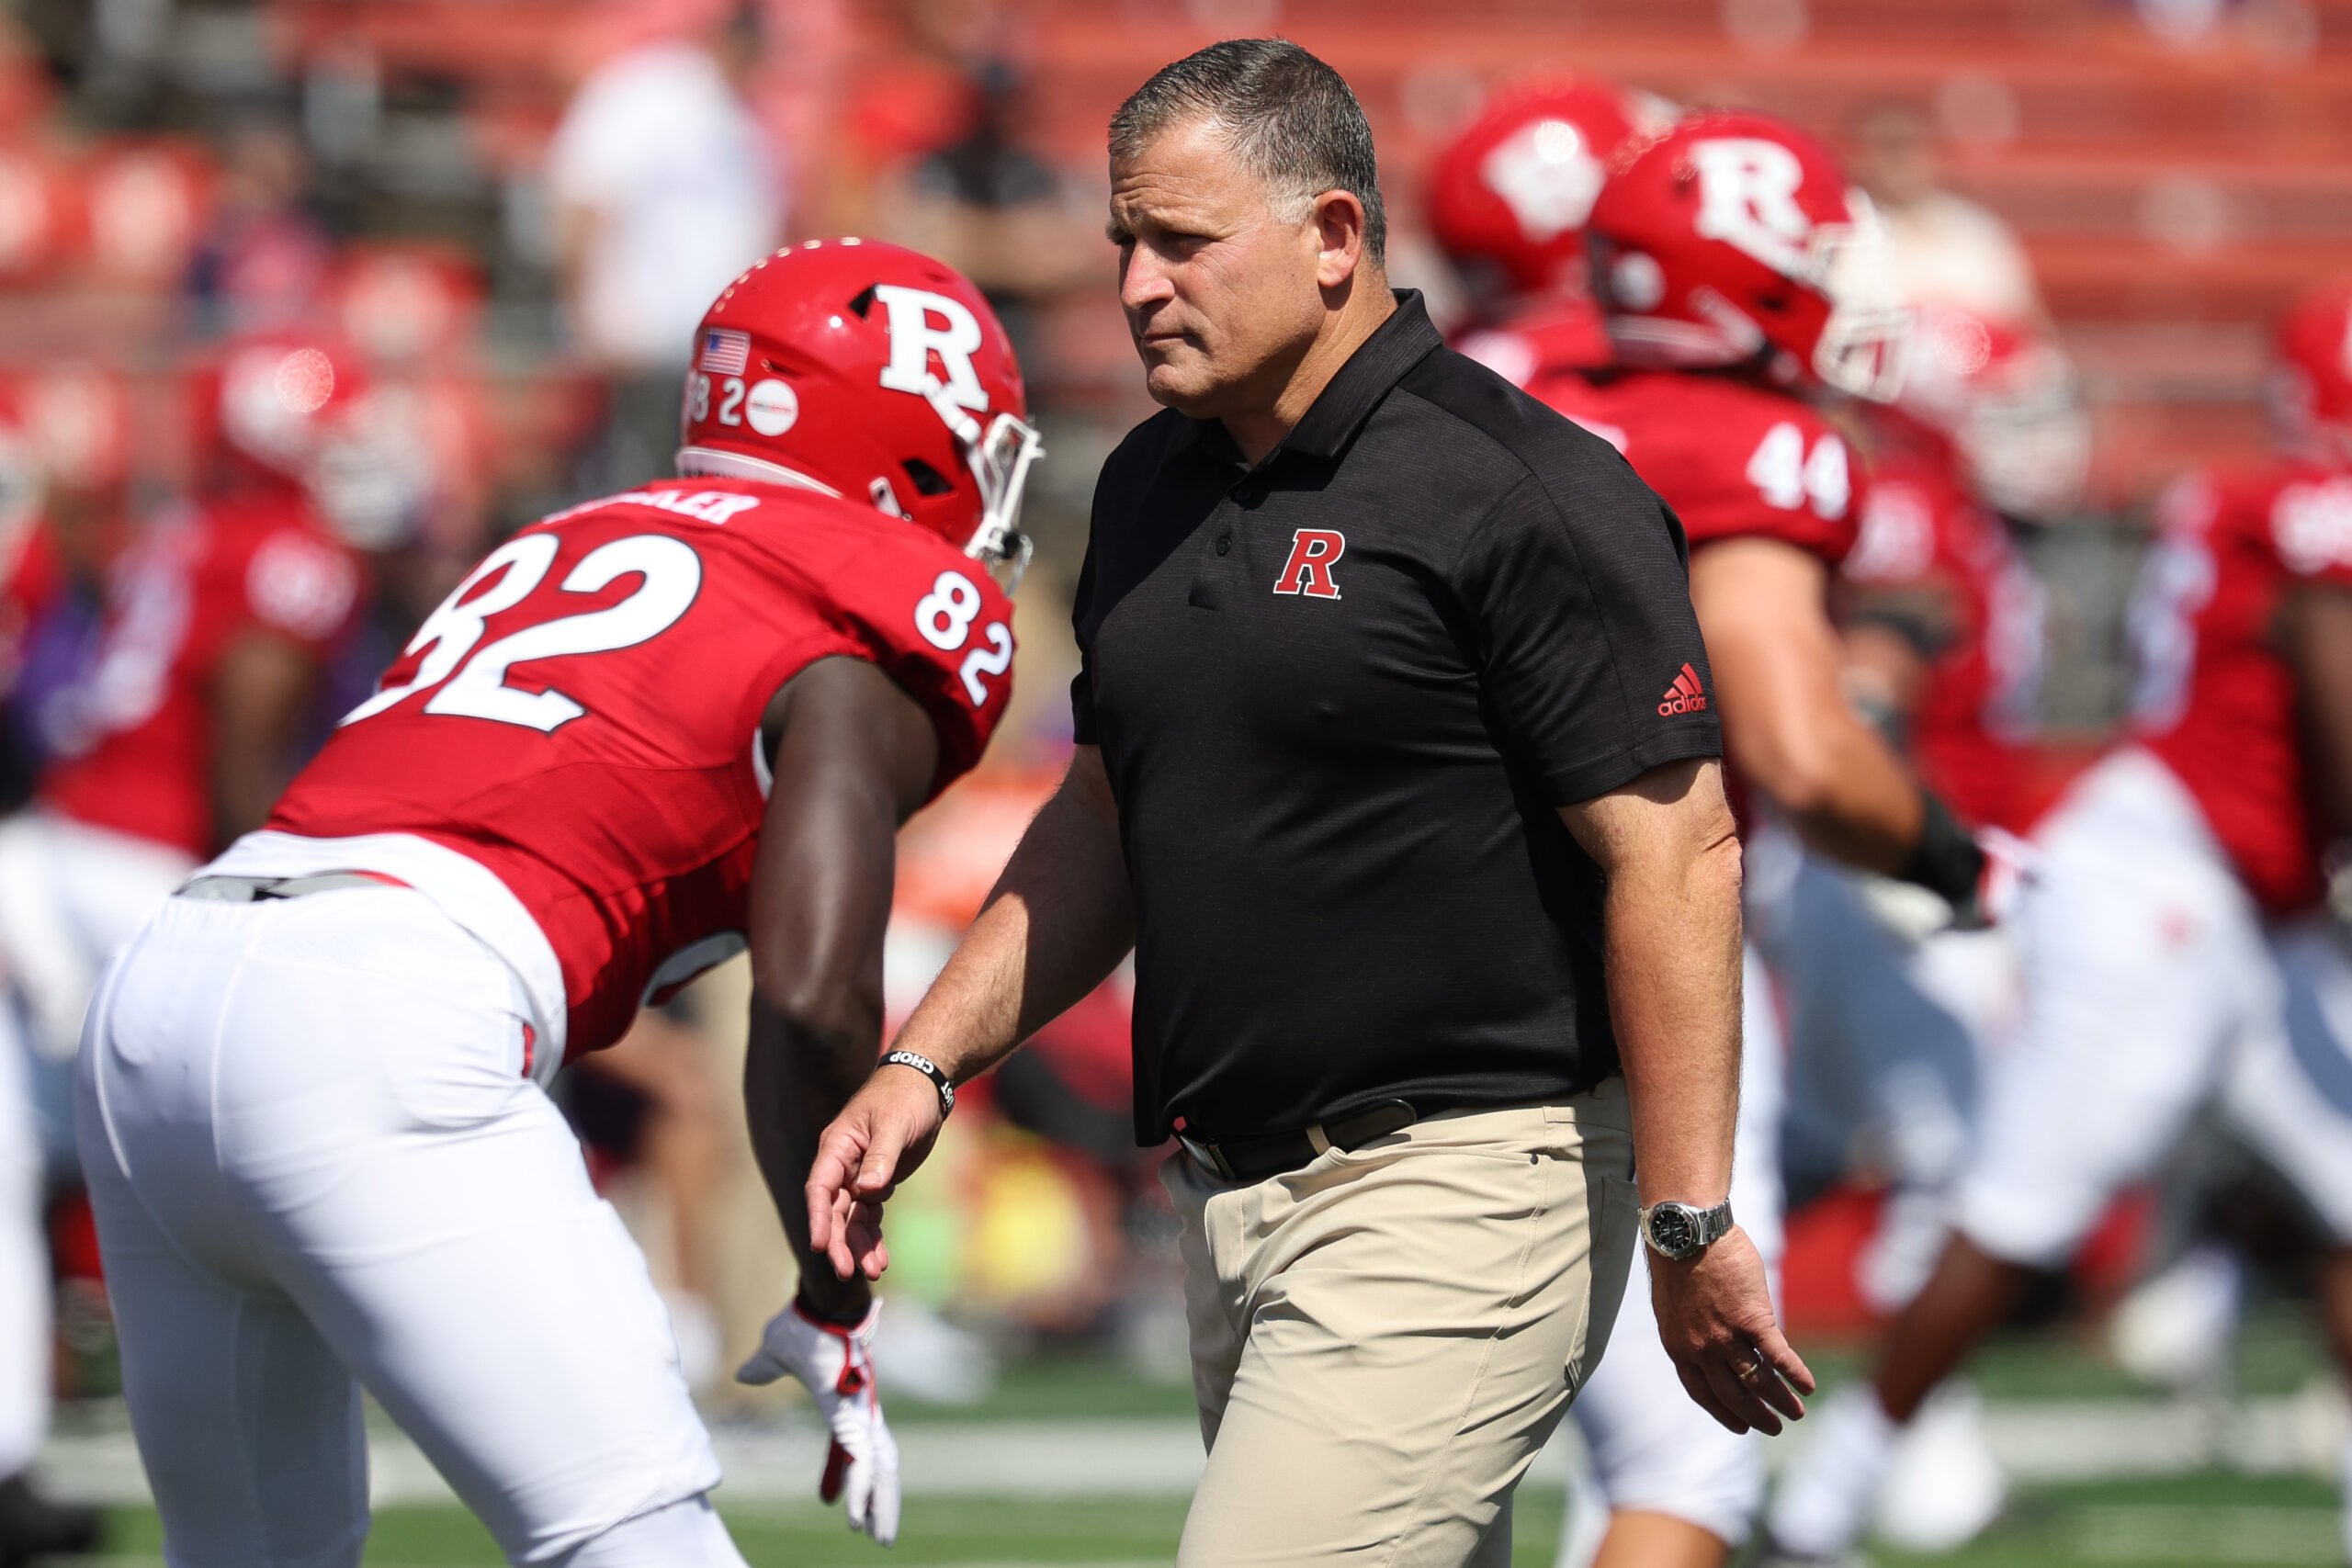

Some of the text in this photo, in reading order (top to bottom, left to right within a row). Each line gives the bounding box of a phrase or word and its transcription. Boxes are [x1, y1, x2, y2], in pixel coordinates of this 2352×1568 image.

[1693, 138, 1816, 254] R
[875, 283, 989, 412] R
[1747, 421, 1849, 522] 44
[1272, 528, 1346, 600] R
[336, 532, 704, 734] 82
[914, 570, 1013, 708] 82
[1657, 694, 1707, 716] adidas
[889, 1051, 955, 1108] UST CHOP
